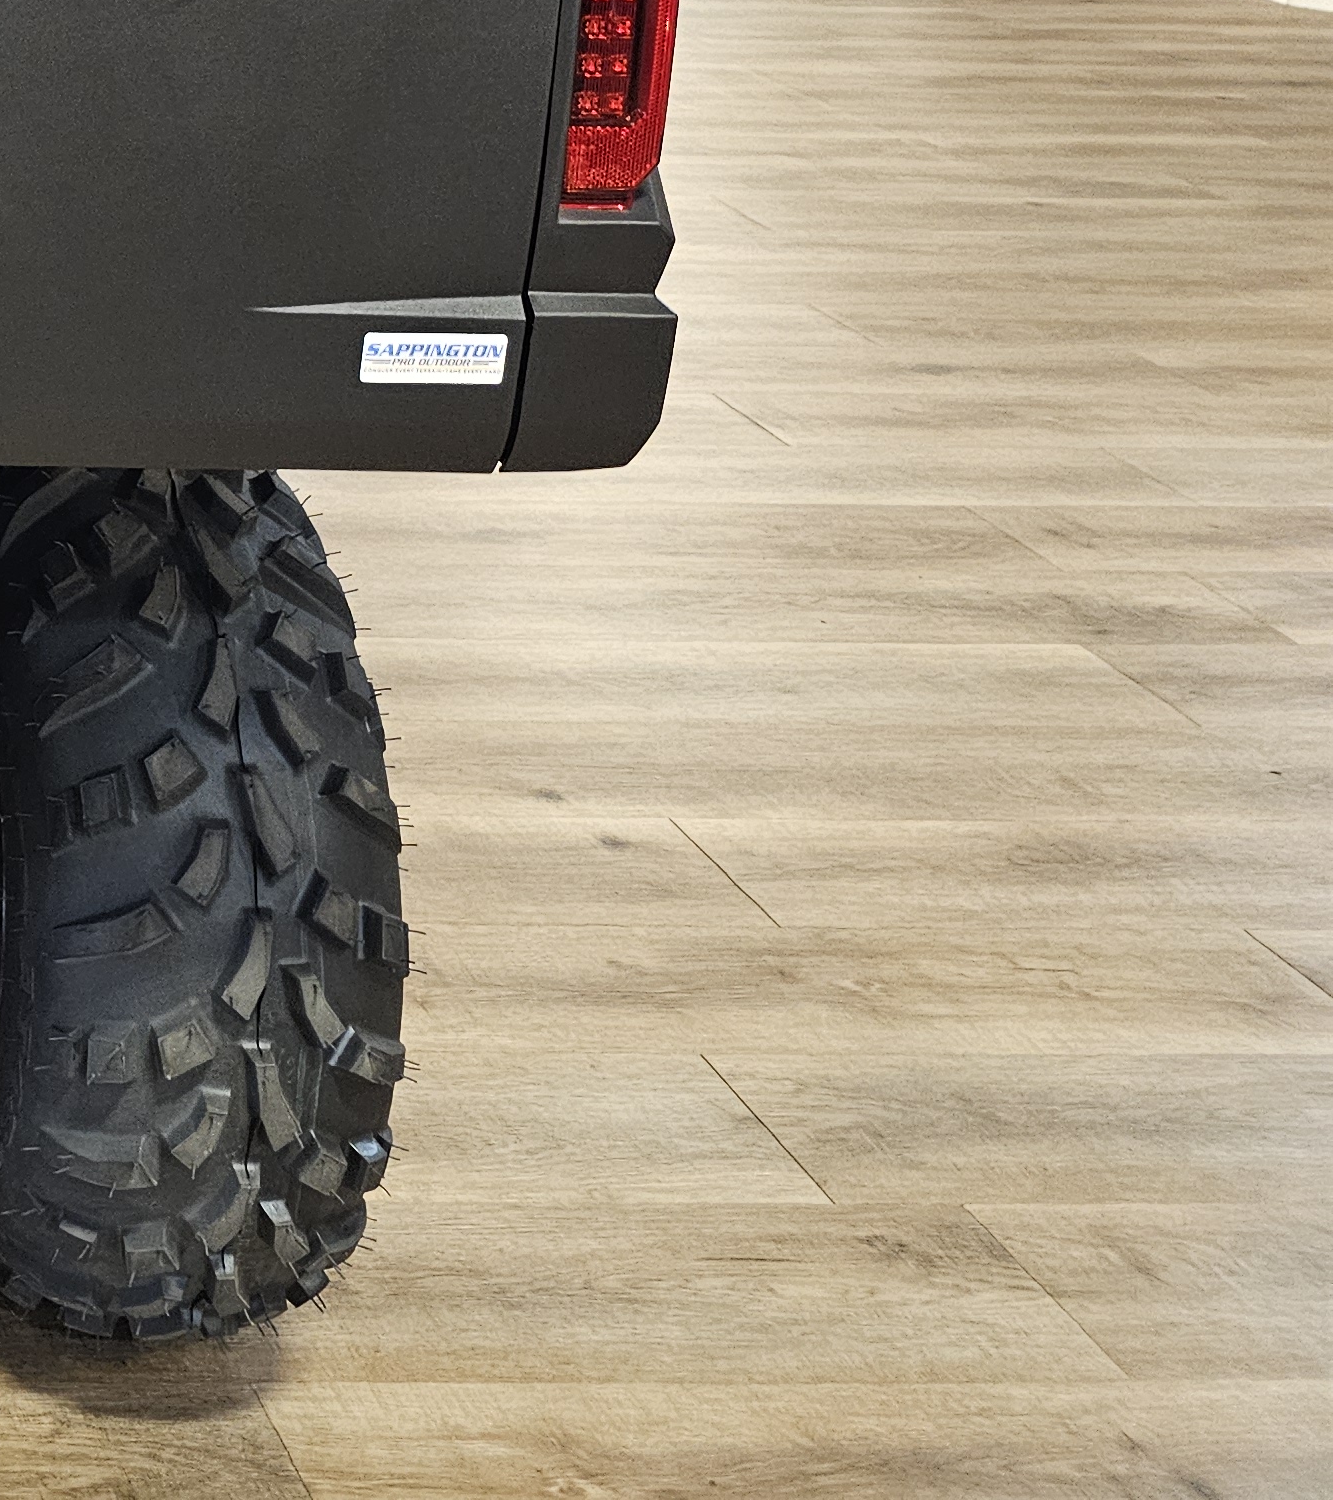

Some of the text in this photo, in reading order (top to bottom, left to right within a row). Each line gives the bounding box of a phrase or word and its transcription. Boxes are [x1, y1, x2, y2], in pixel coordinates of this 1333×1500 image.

[365, 343, 504, 358] SAPPINGTON
[391, 358, 472, 367] PRO OUTDOOR
